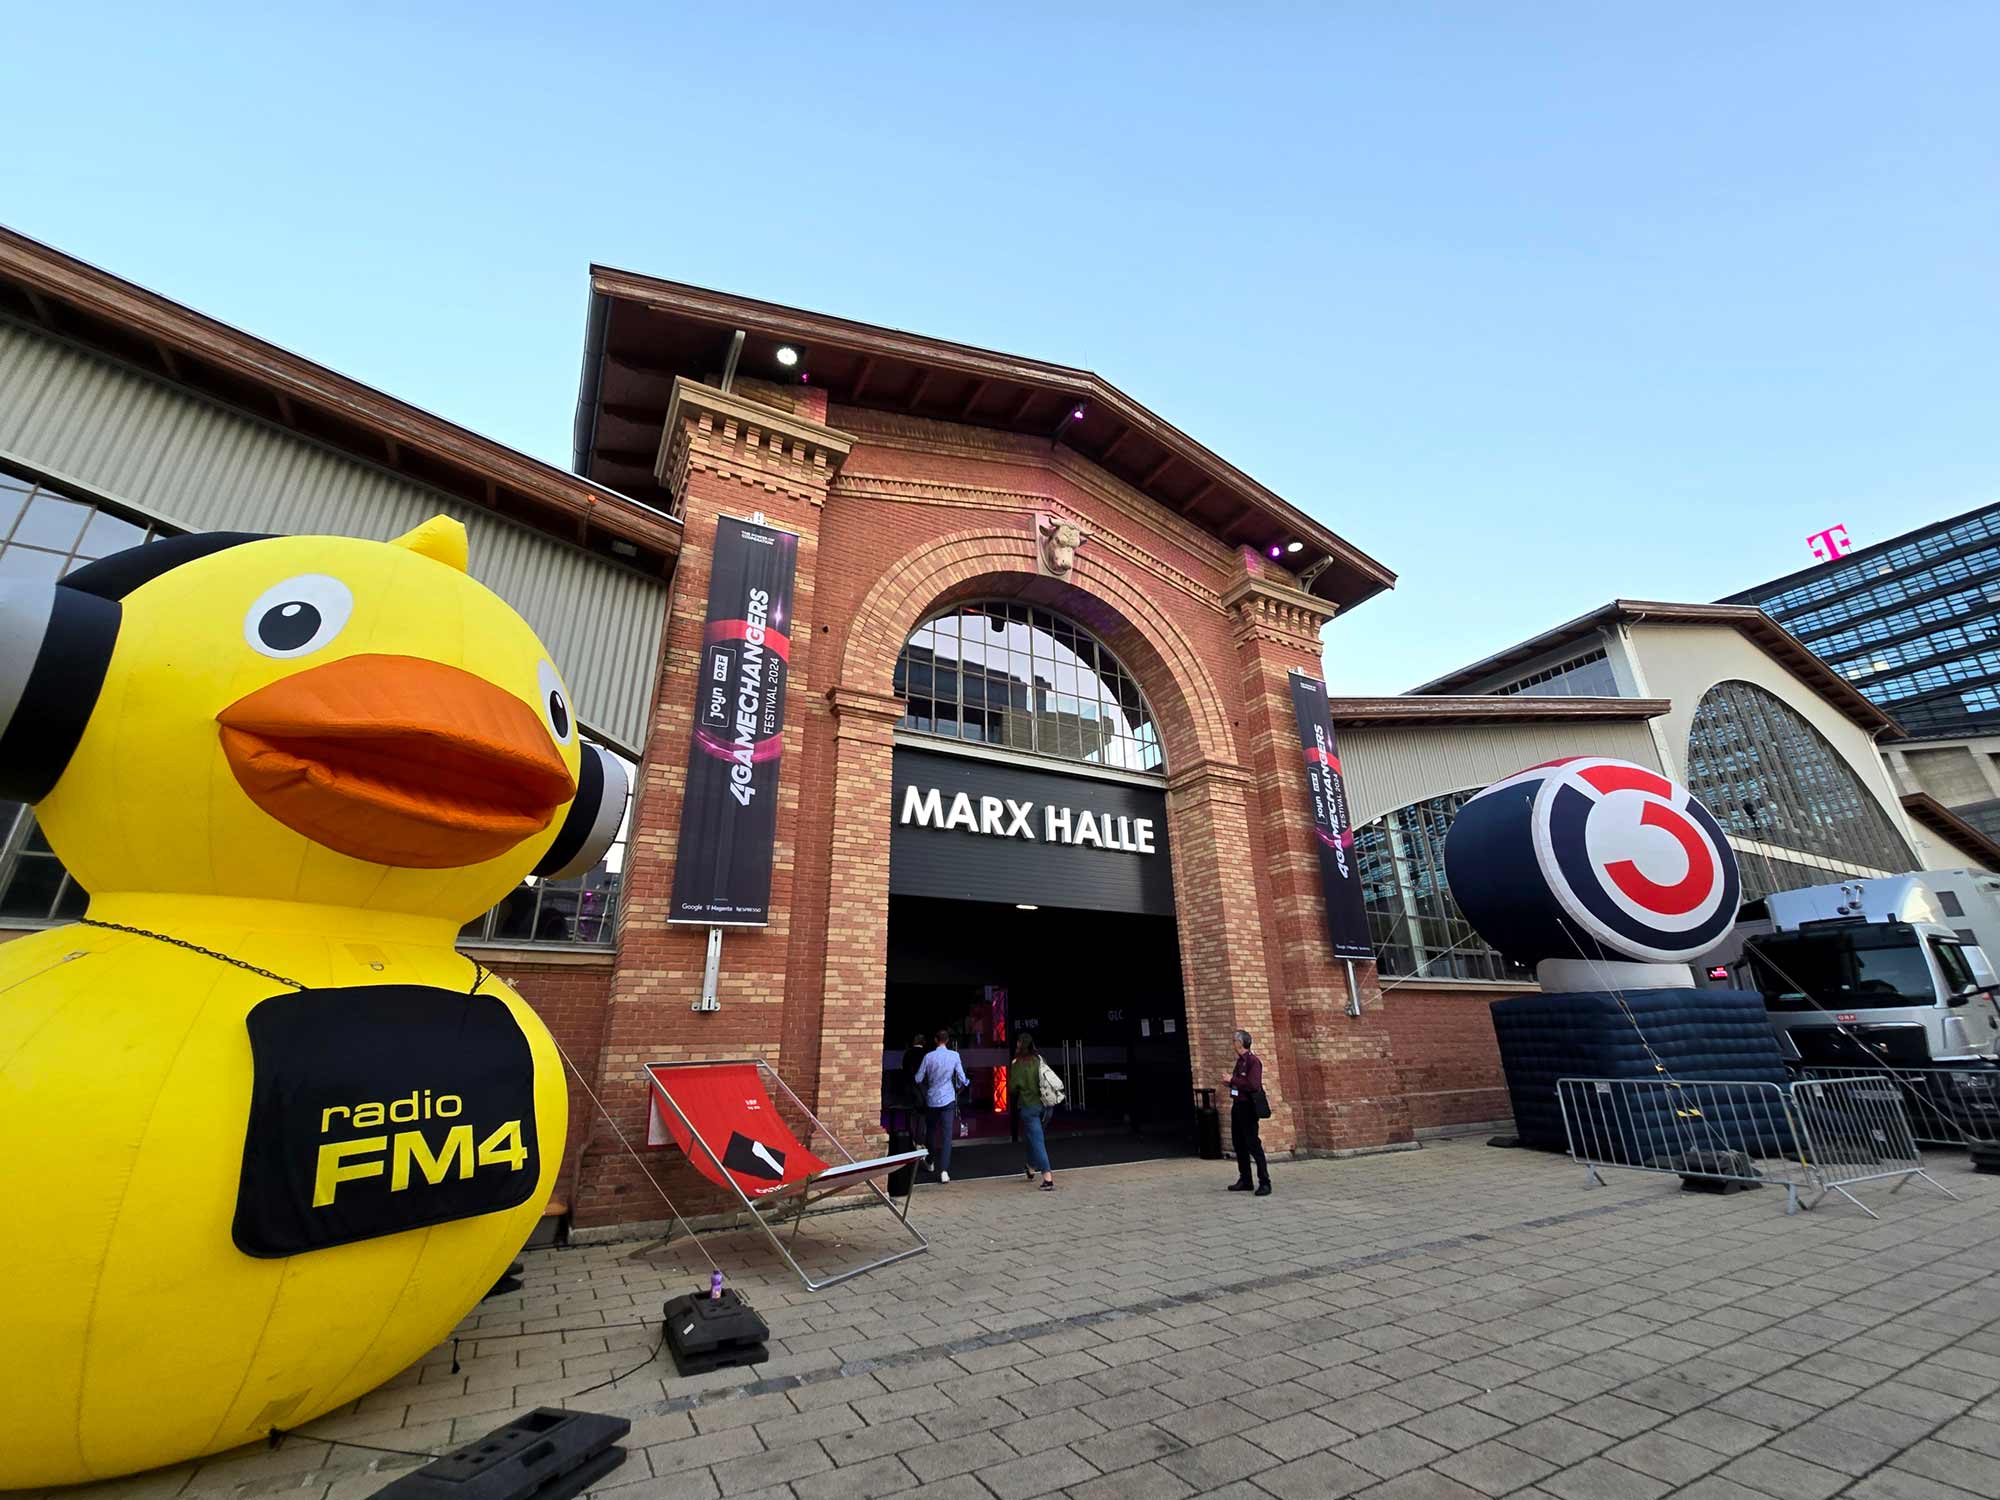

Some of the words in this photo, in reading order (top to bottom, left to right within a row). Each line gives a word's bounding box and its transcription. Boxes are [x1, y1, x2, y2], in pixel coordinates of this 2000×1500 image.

[715, 656, 728, 679] ORF
[769, 657, 780, 685] 2024
[730, 587, 769, 806] 4GAMECHANGERS
[763, 686, 777, 735] FESTIVAL
[900, 785, 1035, 839] MARX
[1044, 805, 1156, 854] HALLE
[1313, 723, 1350, 879] 4GAMECHANGERS
[681, 902, 703, 912] Google
[321, 1089, 463, 1133] radio
[312, 1119, 528, 1208] FM4
